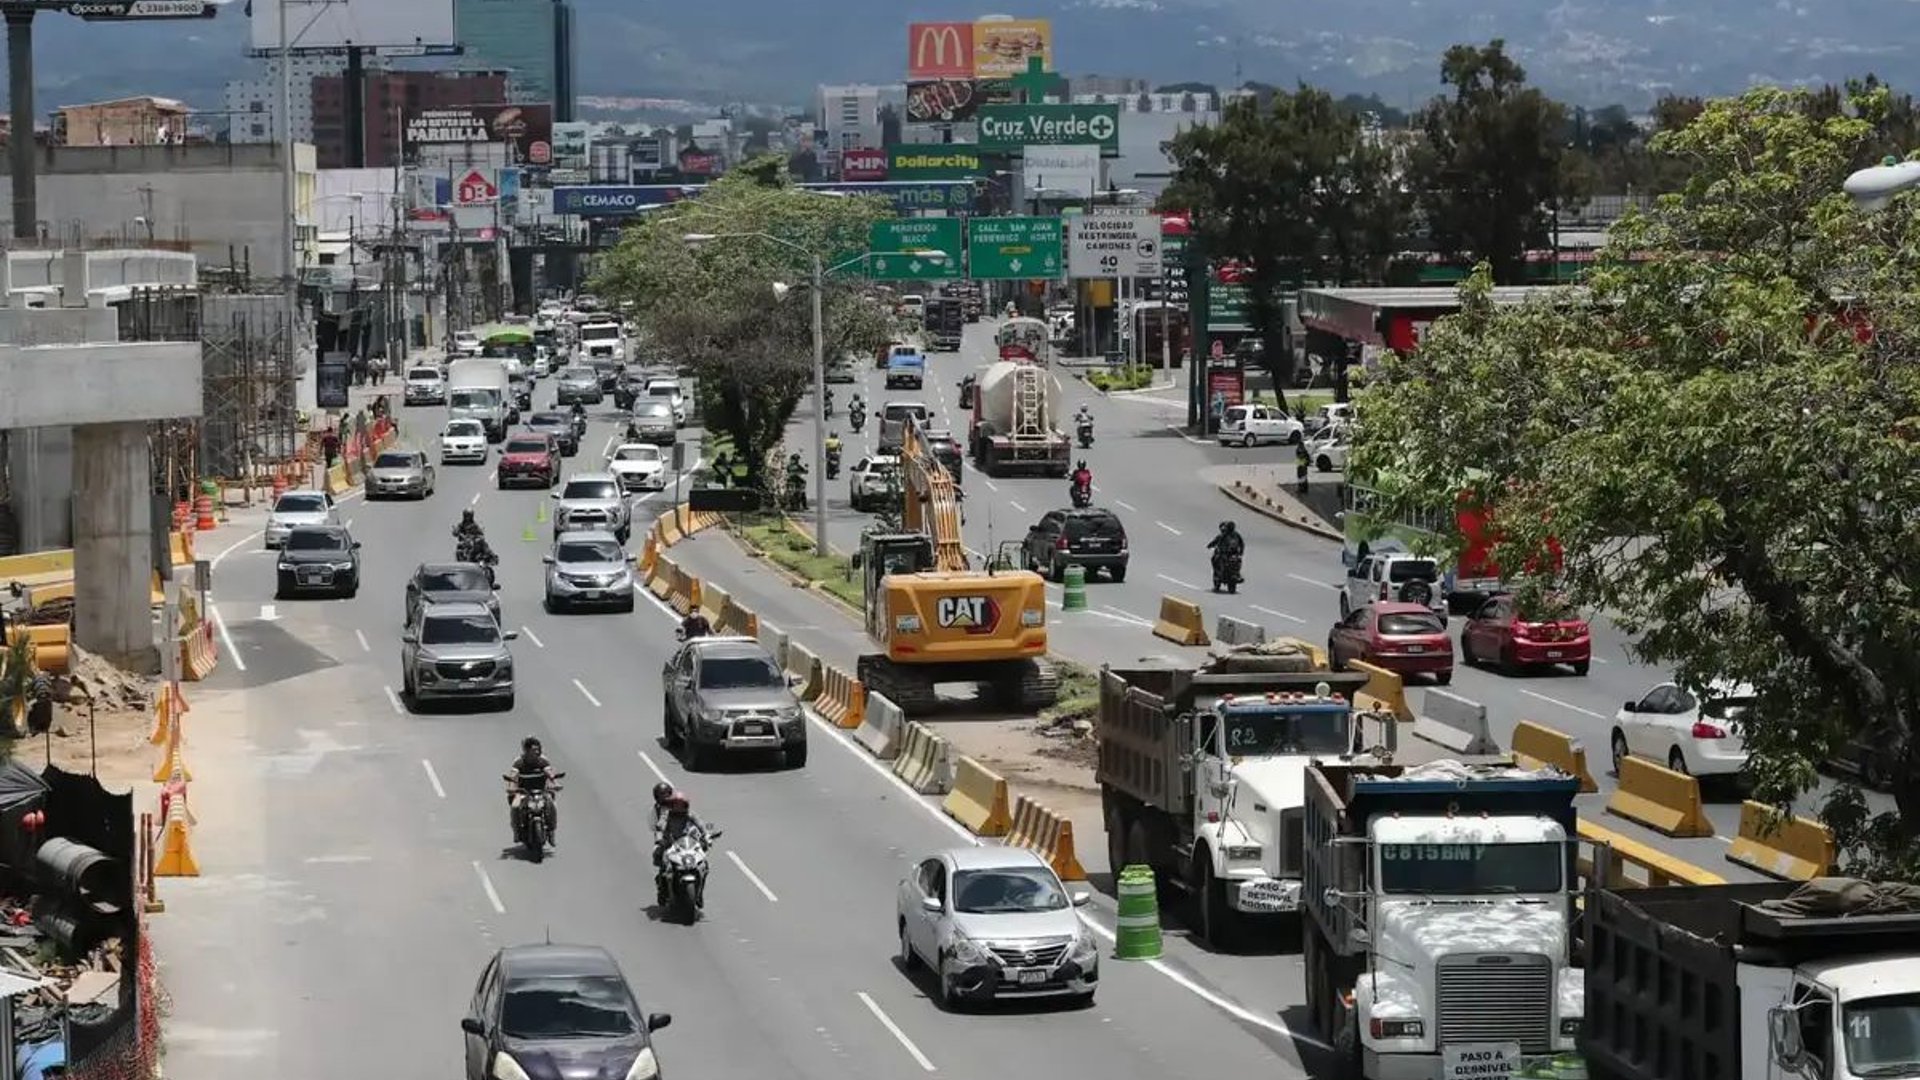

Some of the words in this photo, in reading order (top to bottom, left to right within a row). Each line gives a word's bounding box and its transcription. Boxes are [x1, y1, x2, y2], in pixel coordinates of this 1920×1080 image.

[409, 118, 427, 127] LOS
[428, 118, 458, 127] REYES
[473, 118, 485, 127] LA
[982, 117, 1024, 136] Cruz
[1029, 114, 1087, 135] Verde
[407, 128, 489, 141] PARRILLA
[896, 154, 978, 169] Dollarcity
[583, 195, 635, 206] CEMACO
[1010, 223, 1027, 232] SAN
[1032, 222, 1052, 231] JUAN
[1083, 221, 1133, 230] VELOCIDAD
[1030, 232, 1057, 242] NORTE
[1078, 232, 1137, 240] RESTRINGIDA
[1086, 242, 1131, 250] CAMIONES
[1100, 255, 1118, 266] 40
[938, 597, 985, 627] CAT
[1850, 1016, 1870, 1038] 11
[1461, 1051, 1492, 1061] PASO
[1495, 1050, 1503, 1060] A
[1455, 1063, 1514, 1075] DESNIVEL
